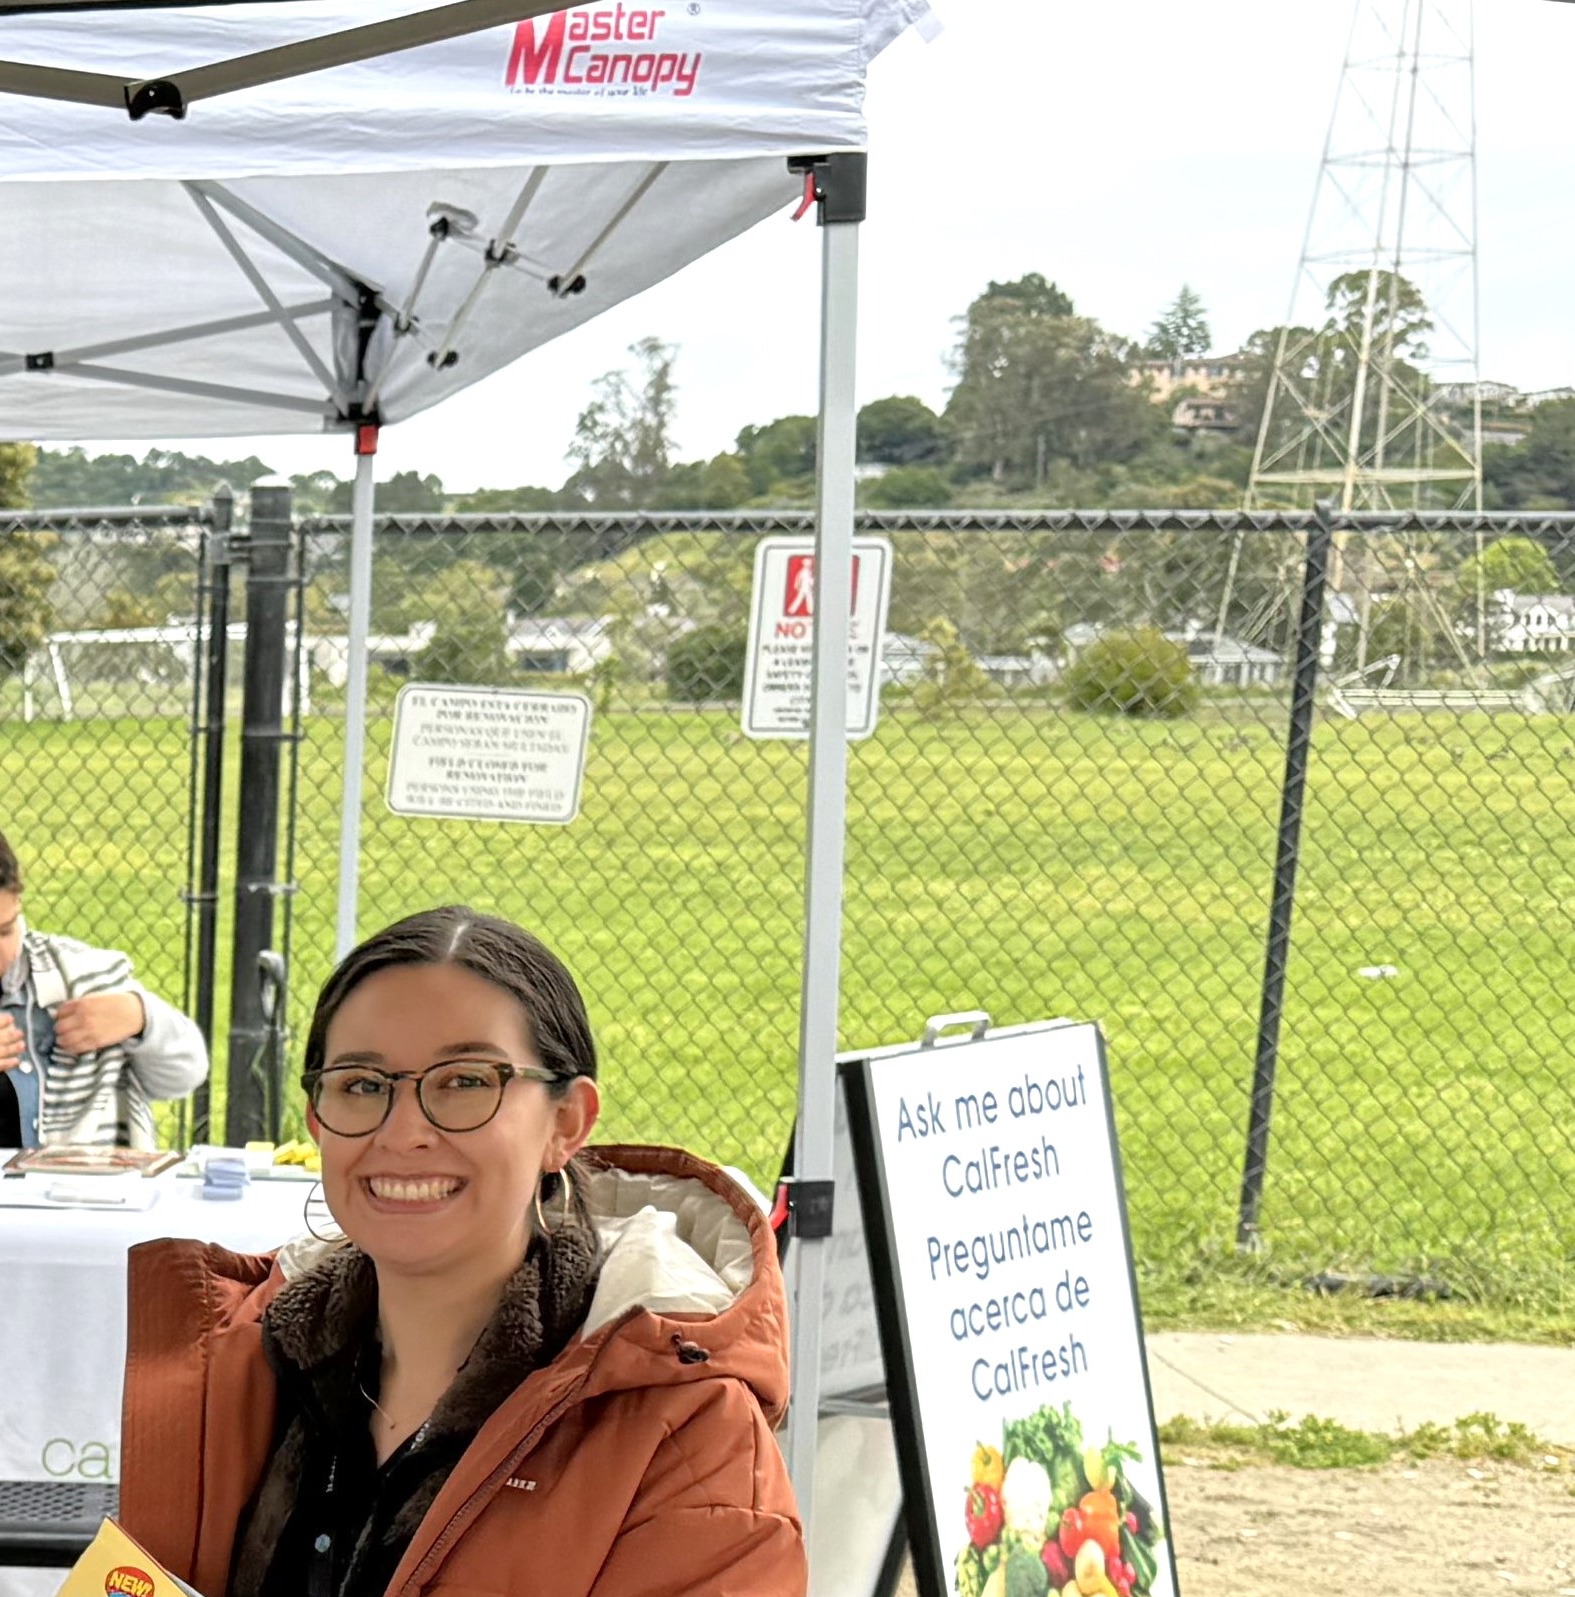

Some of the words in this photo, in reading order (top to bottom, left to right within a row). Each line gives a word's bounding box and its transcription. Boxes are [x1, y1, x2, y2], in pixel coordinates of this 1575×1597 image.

[505, 2, 665, 87] Master
[563, 45, 701, 97] Canopy
[896, 1090, 947, 1144] Ask
[954, 1090, 999, 1132] me
[1008, 1063, 1087, 1119] about
[941, 1134, 1061, 1199] CalFresh
[926, 1209, 1094, 1281] Preguntame
[949, 1286, 1048, 1342] acerca
[1054, 1267, 1092, 1314] de
[970, 1331, 1089, 1402] CalFresh
